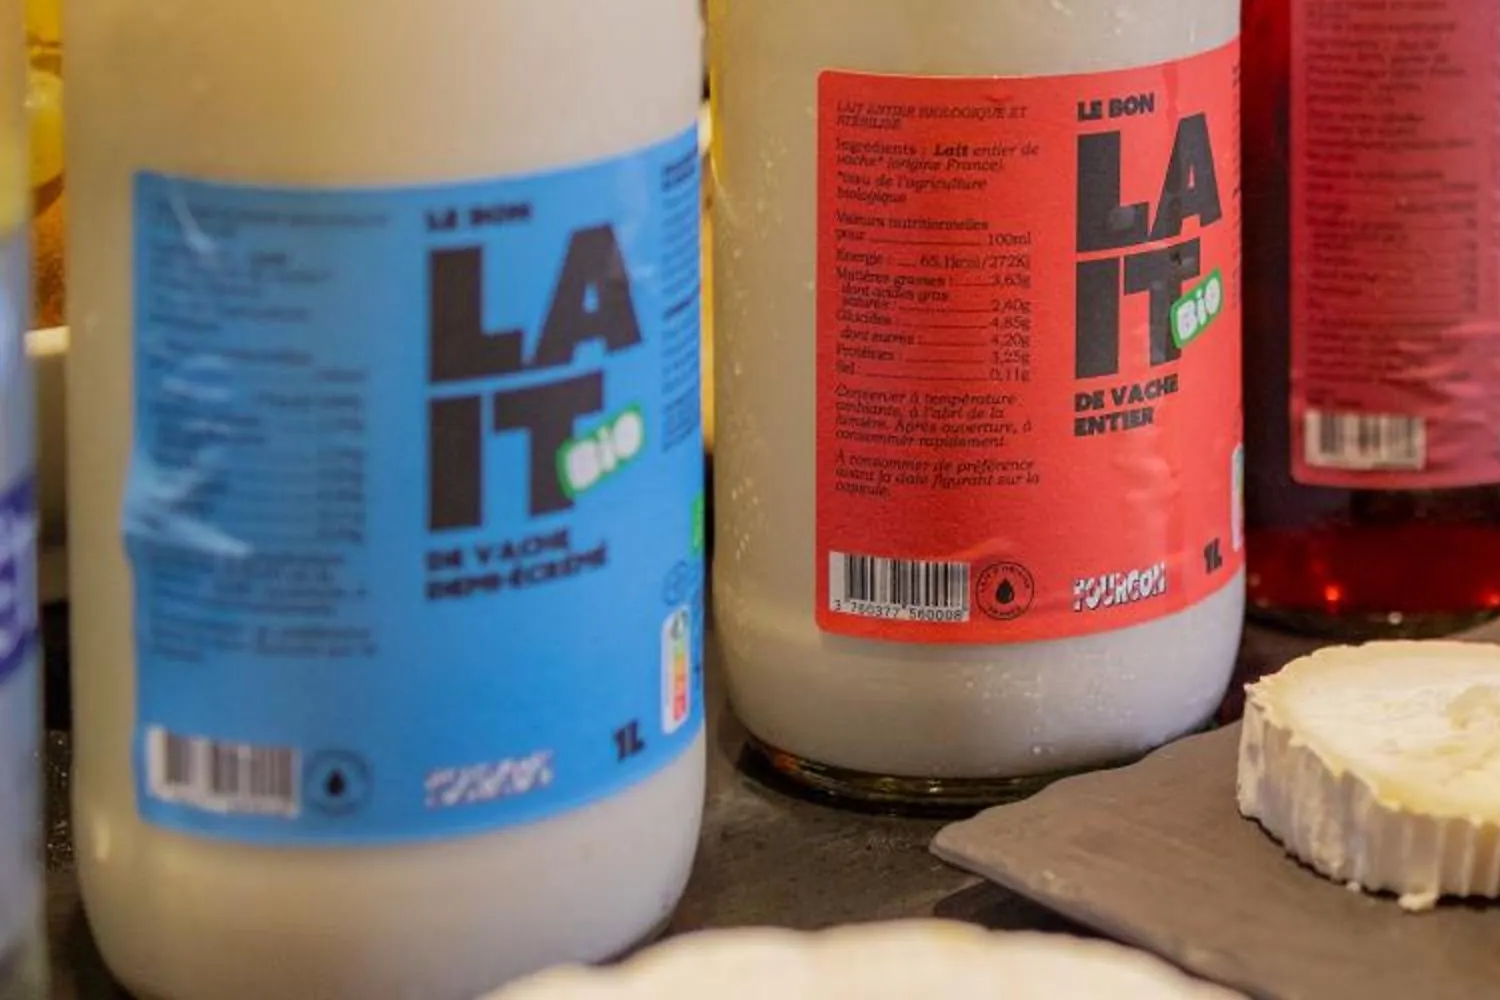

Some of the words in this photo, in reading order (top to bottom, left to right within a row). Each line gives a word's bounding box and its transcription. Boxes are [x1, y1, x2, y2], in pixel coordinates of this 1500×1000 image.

[1077, 100, 1103, 122] LE
[1108, 91, 1155, 119] BON
[1076, 112, 1222, 253] LA
[429, 222, 642, 385] LA
[1075, 236, 1201, 380] IT
[429, 369, 605, 531] IT
[1074, 389, 1105, 412] DE
[1111, 372, 1179, 405] VACHE
[1074, 406, 1155, 437] ENTIER
